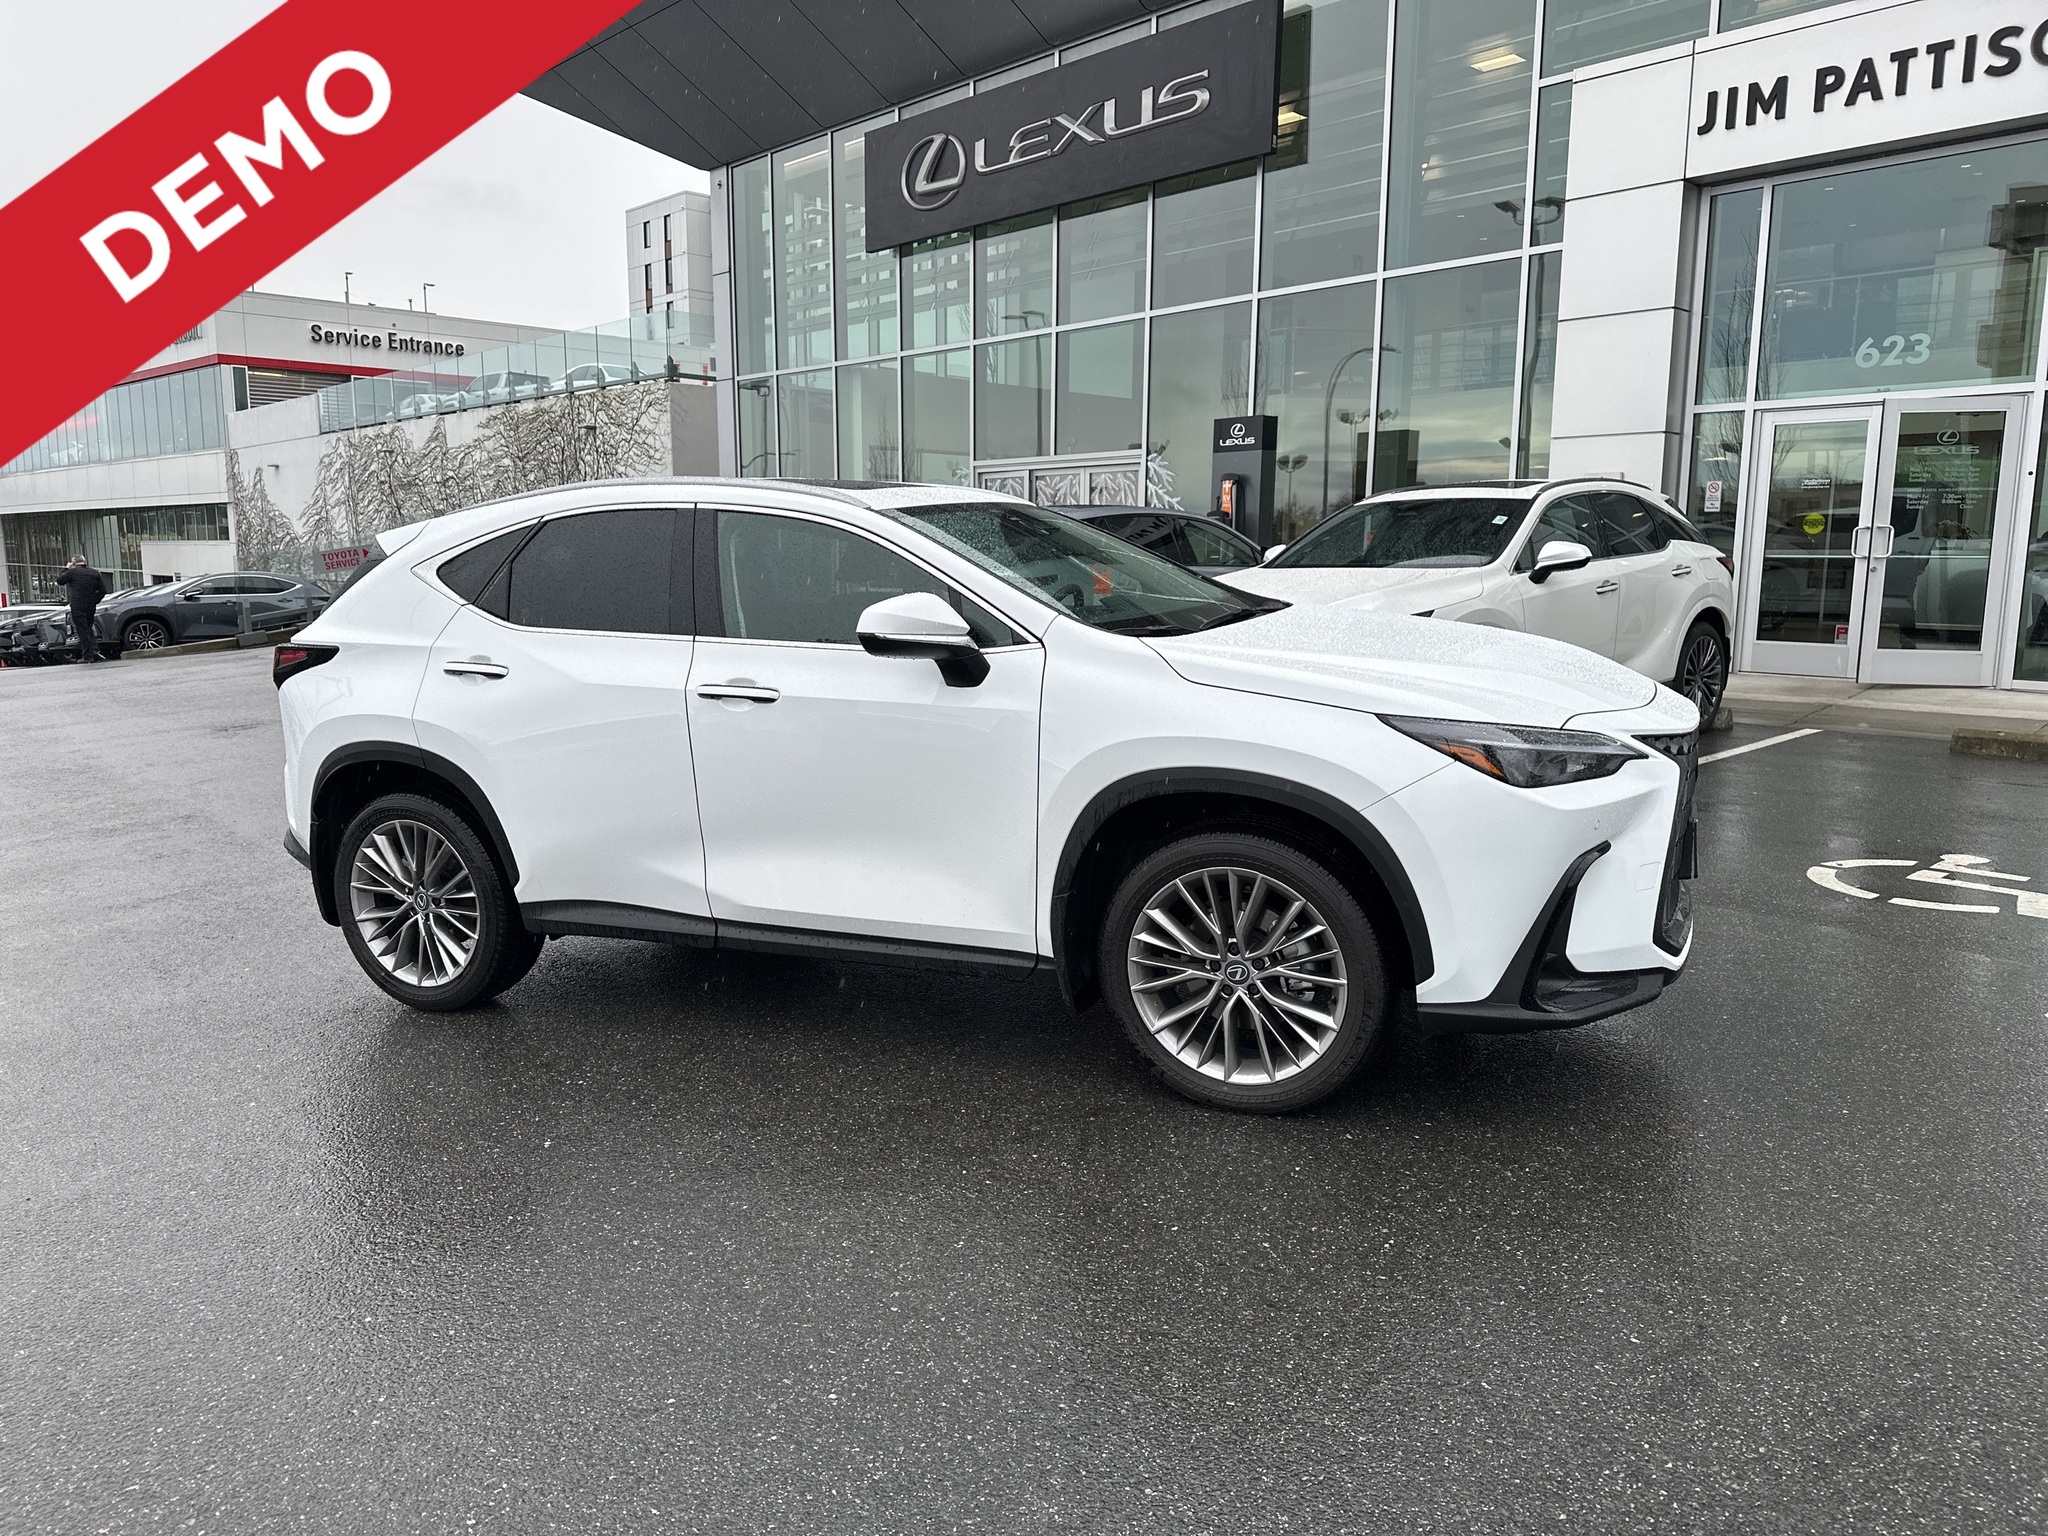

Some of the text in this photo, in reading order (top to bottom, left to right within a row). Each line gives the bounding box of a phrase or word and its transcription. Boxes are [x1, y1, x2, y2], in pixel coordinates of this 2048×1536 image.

[1697, 75, 1789, 136] JIM
[974, 69, 1211, 175] LEXUS
[310, 324, 465, 356] Service Entrance
[1855, 332, 1931, 369] 623
[1219, 436, 1255, 446] LEXUS
[1913, 445, 1980, 455] LEXUS
[321, 548, 360, 562] TOYOTA
[324, 557, 361, 571] SERVICE
